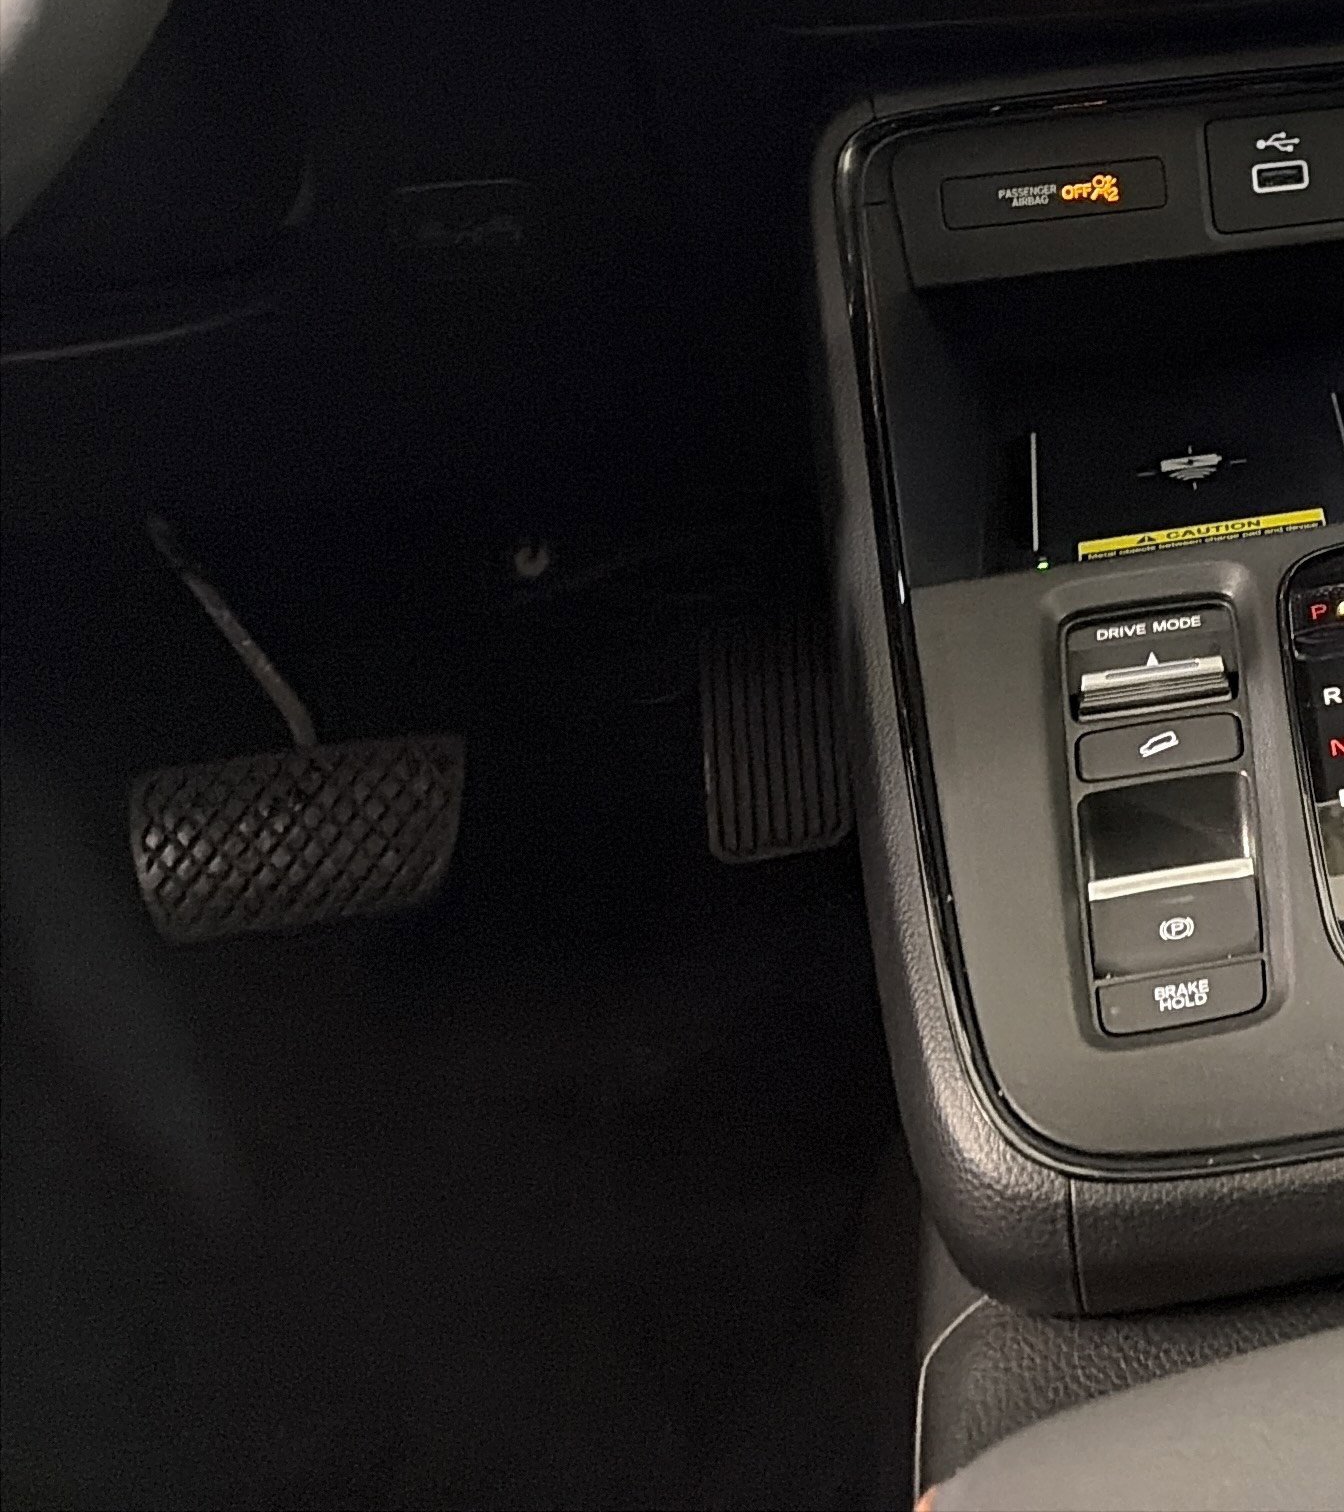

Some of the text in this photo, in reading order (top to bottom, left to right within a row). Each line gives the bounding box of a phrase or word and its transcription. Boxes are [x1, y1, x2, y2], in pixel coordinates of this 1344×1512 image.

[998, 184, 1057, 199] PASSENGER
[1061, 183, 1092, 200] OFF
[1012, 195, 1049, 207] AIRBAG
[1166, 519, 1261, 539] CAUTION
[1310, 603, 1328, 620] P
[1096, 615, 1202, 641] DRIVE MODE
[1323, 687, 1343, 705] R
[1154, 979, 1209, 1001] BRAKE
[1159, 993, 1208, 1012] HOLD
